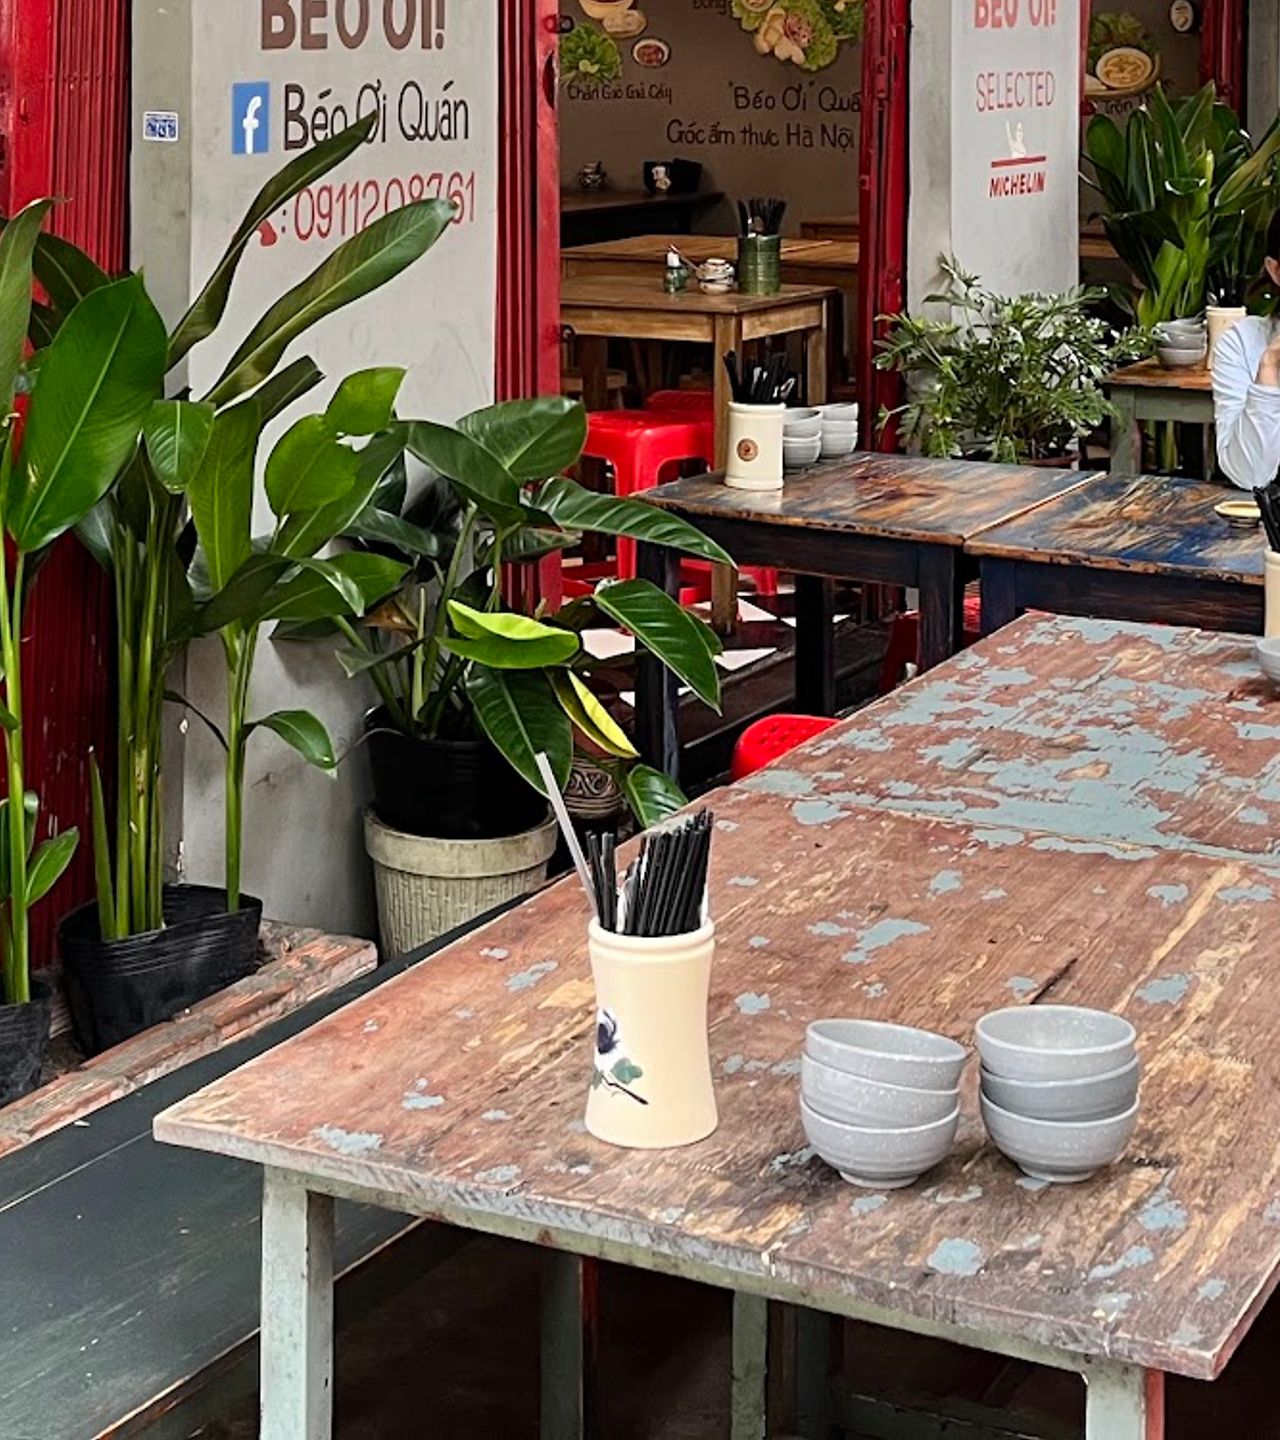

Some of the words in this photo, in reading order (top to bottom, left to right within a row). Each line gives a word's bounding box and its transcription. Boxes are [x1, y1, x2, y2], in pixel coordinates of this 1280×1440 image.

[818, 86, 863, 113] Quá
[976, 70, 1056, 113] SELECTED
[284, 82, 349, 152] Béo
[356, 78, 387, 144] Ơi
[398, 80, 469, 142] Quán
[666, 118, 707, 145] Góc
[821, 123, 856, 153] Nội
[989, 170, 1047, 198] MICHELIN
